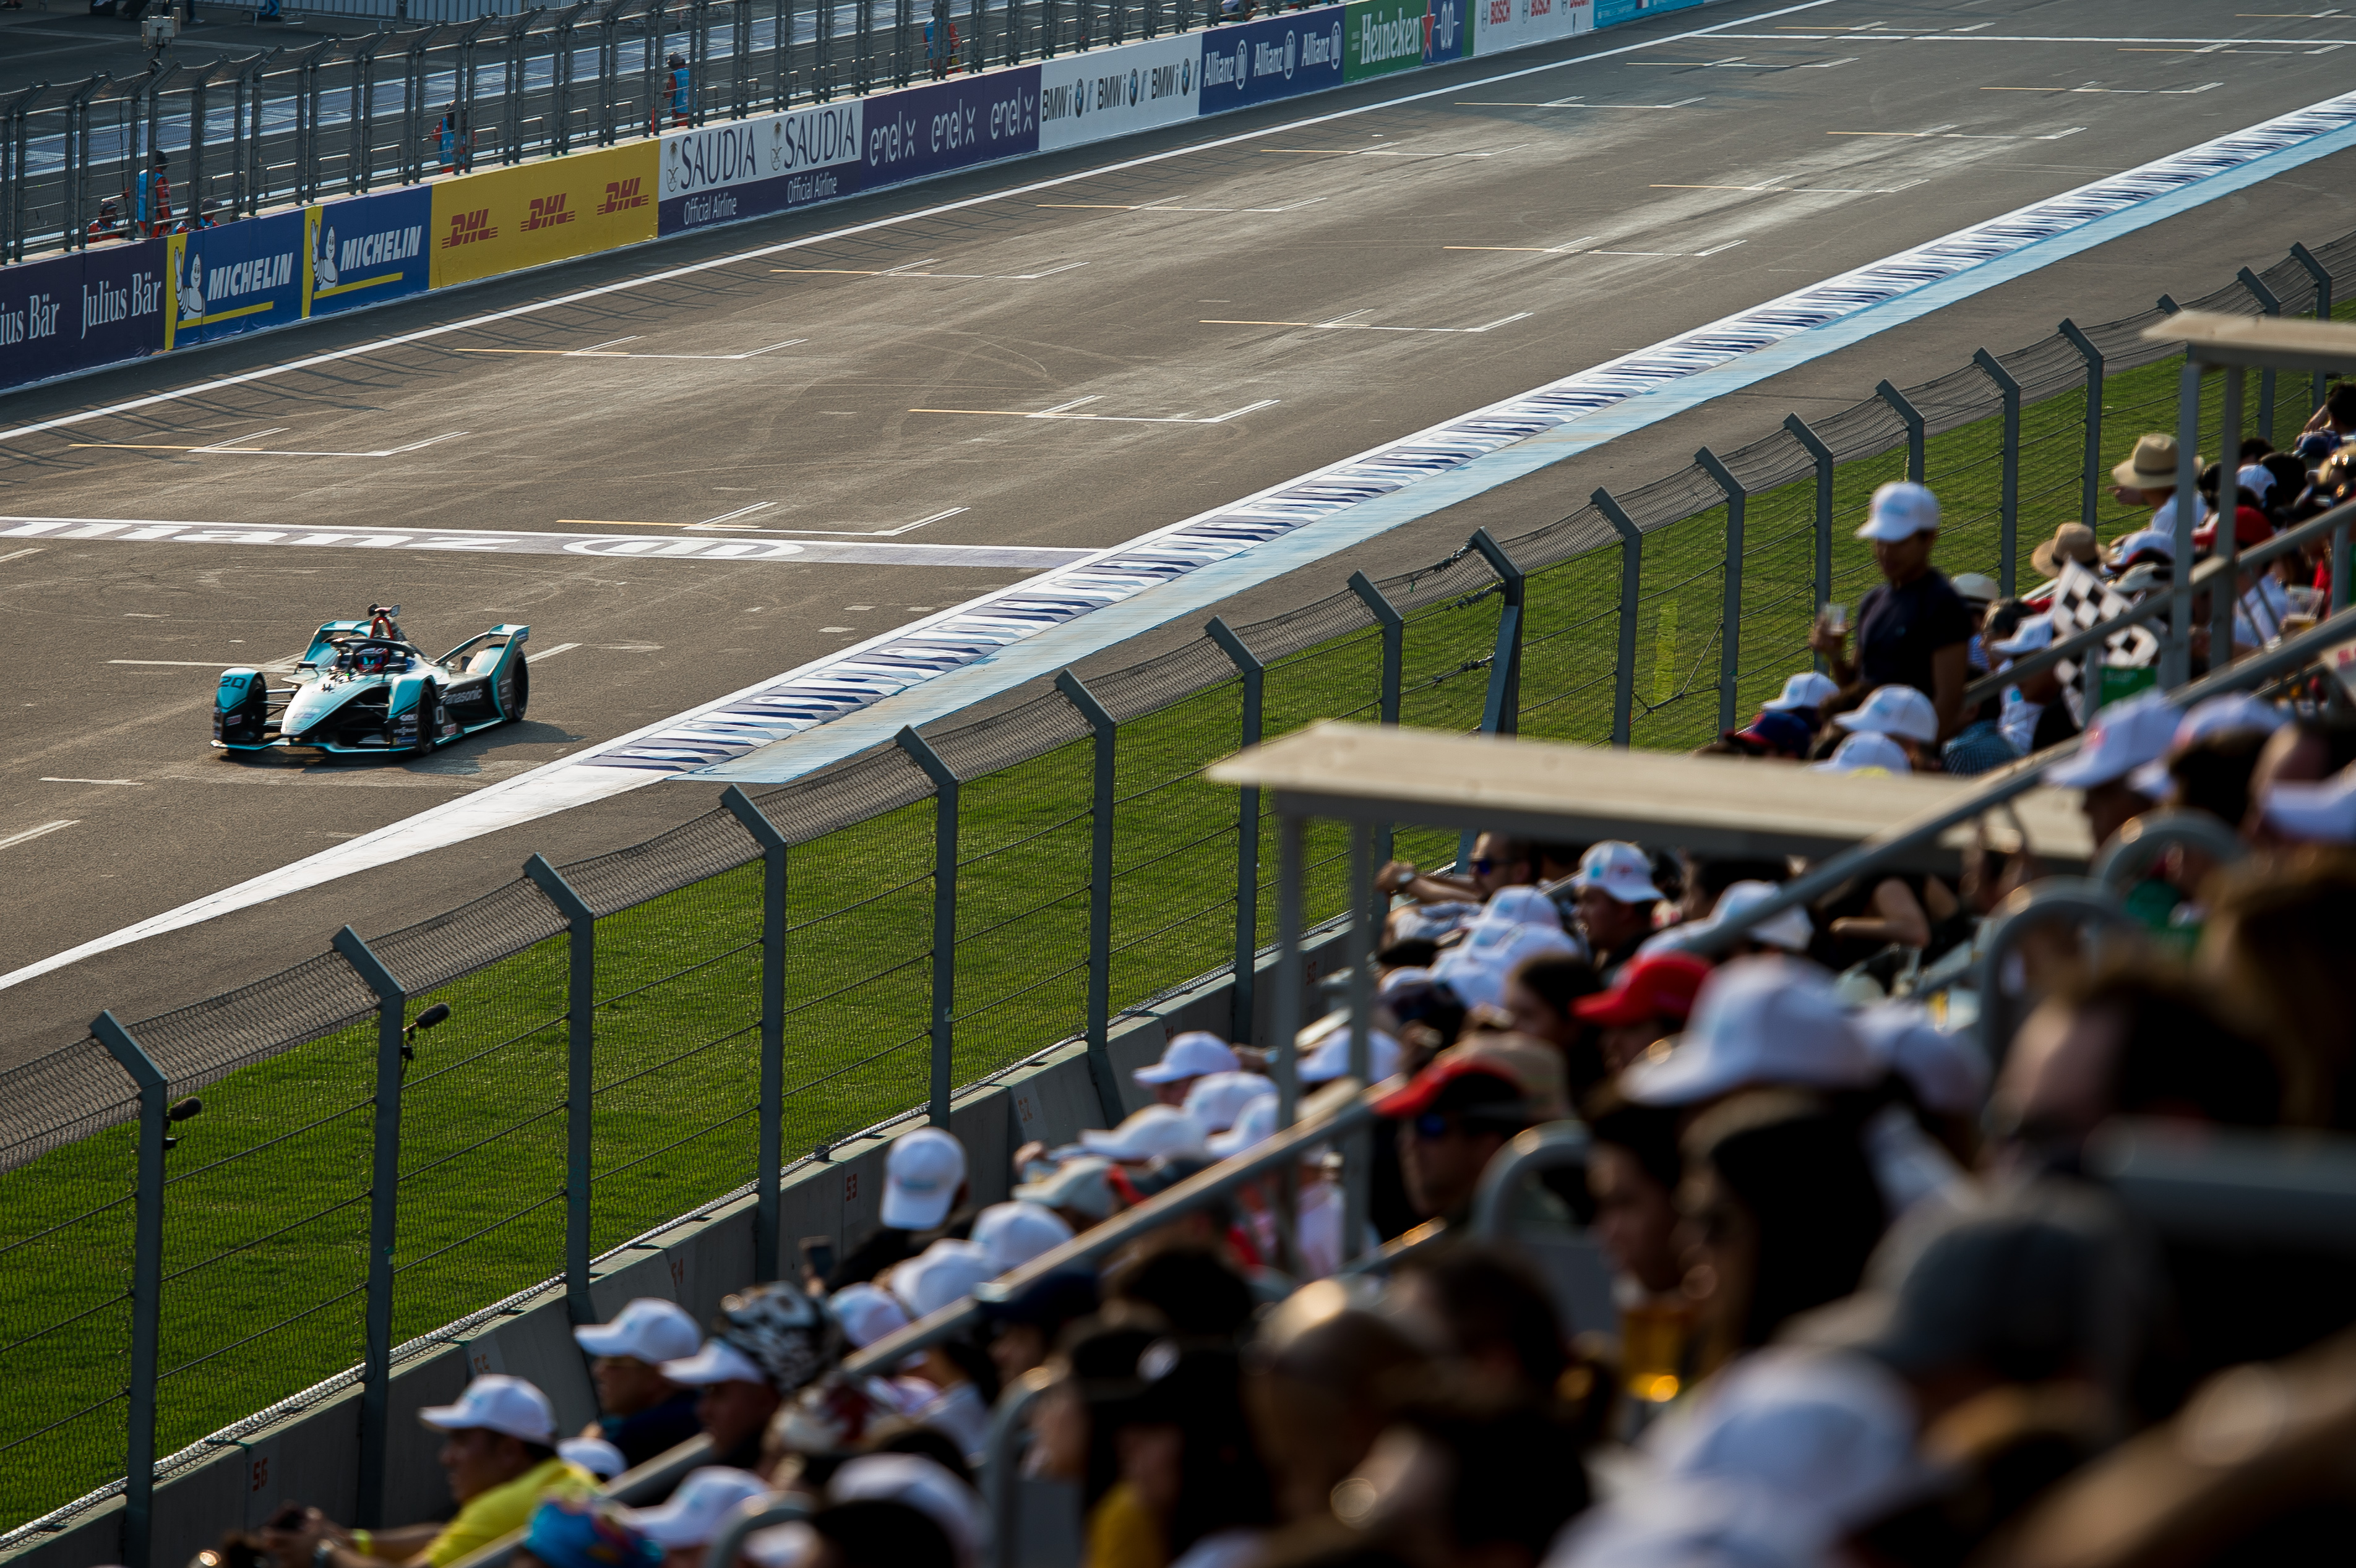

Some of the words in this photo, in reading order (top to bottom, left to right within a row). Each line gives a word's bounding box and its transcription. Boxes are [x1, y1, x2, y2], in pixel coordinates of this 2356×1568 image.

[1301, 32, 1330, 67] Allianz
[1361, 7, 1420, 64] Heineken
[1203, 50, 1235, 87] Allianz
[1253, 41, 1283, 77] Allianz
[1098, 74, 1122, 110] BMW
[1151, 64, 1176, 100] BMW
[991, 87, 1021, 140] enel
[1042, 85, 1068, 122] BMW
[784, 106, 856, 169] SAUDIA
[869, 111, 902, 166] enel
[931, 98, 962, 153] enel
[681, 125, 756, 190] SAUDIA
[604, 177, 643, 214] DHL
[787, 176, 813, 203] Official
[814, 172, 838, 199] Airline
[527, 193, 569, 231] DHL
[684, 196, 711, 225] Official
[712, 192, 737, 218] Airline
[449, 208, 491, 247] DHL
[340, 225, 422, 272] MICHELIN
[207, 252, 293, 301] MICHELIN
[28, 293, 60, 340] Bär
[81, 280, 127, 340] Julius
[131, 272, 162, 317] Bär
[220, 675, 247, 690] 20
[846, 1173, 857, 1202] 53
[252, 1457, 268, 1492] 56
